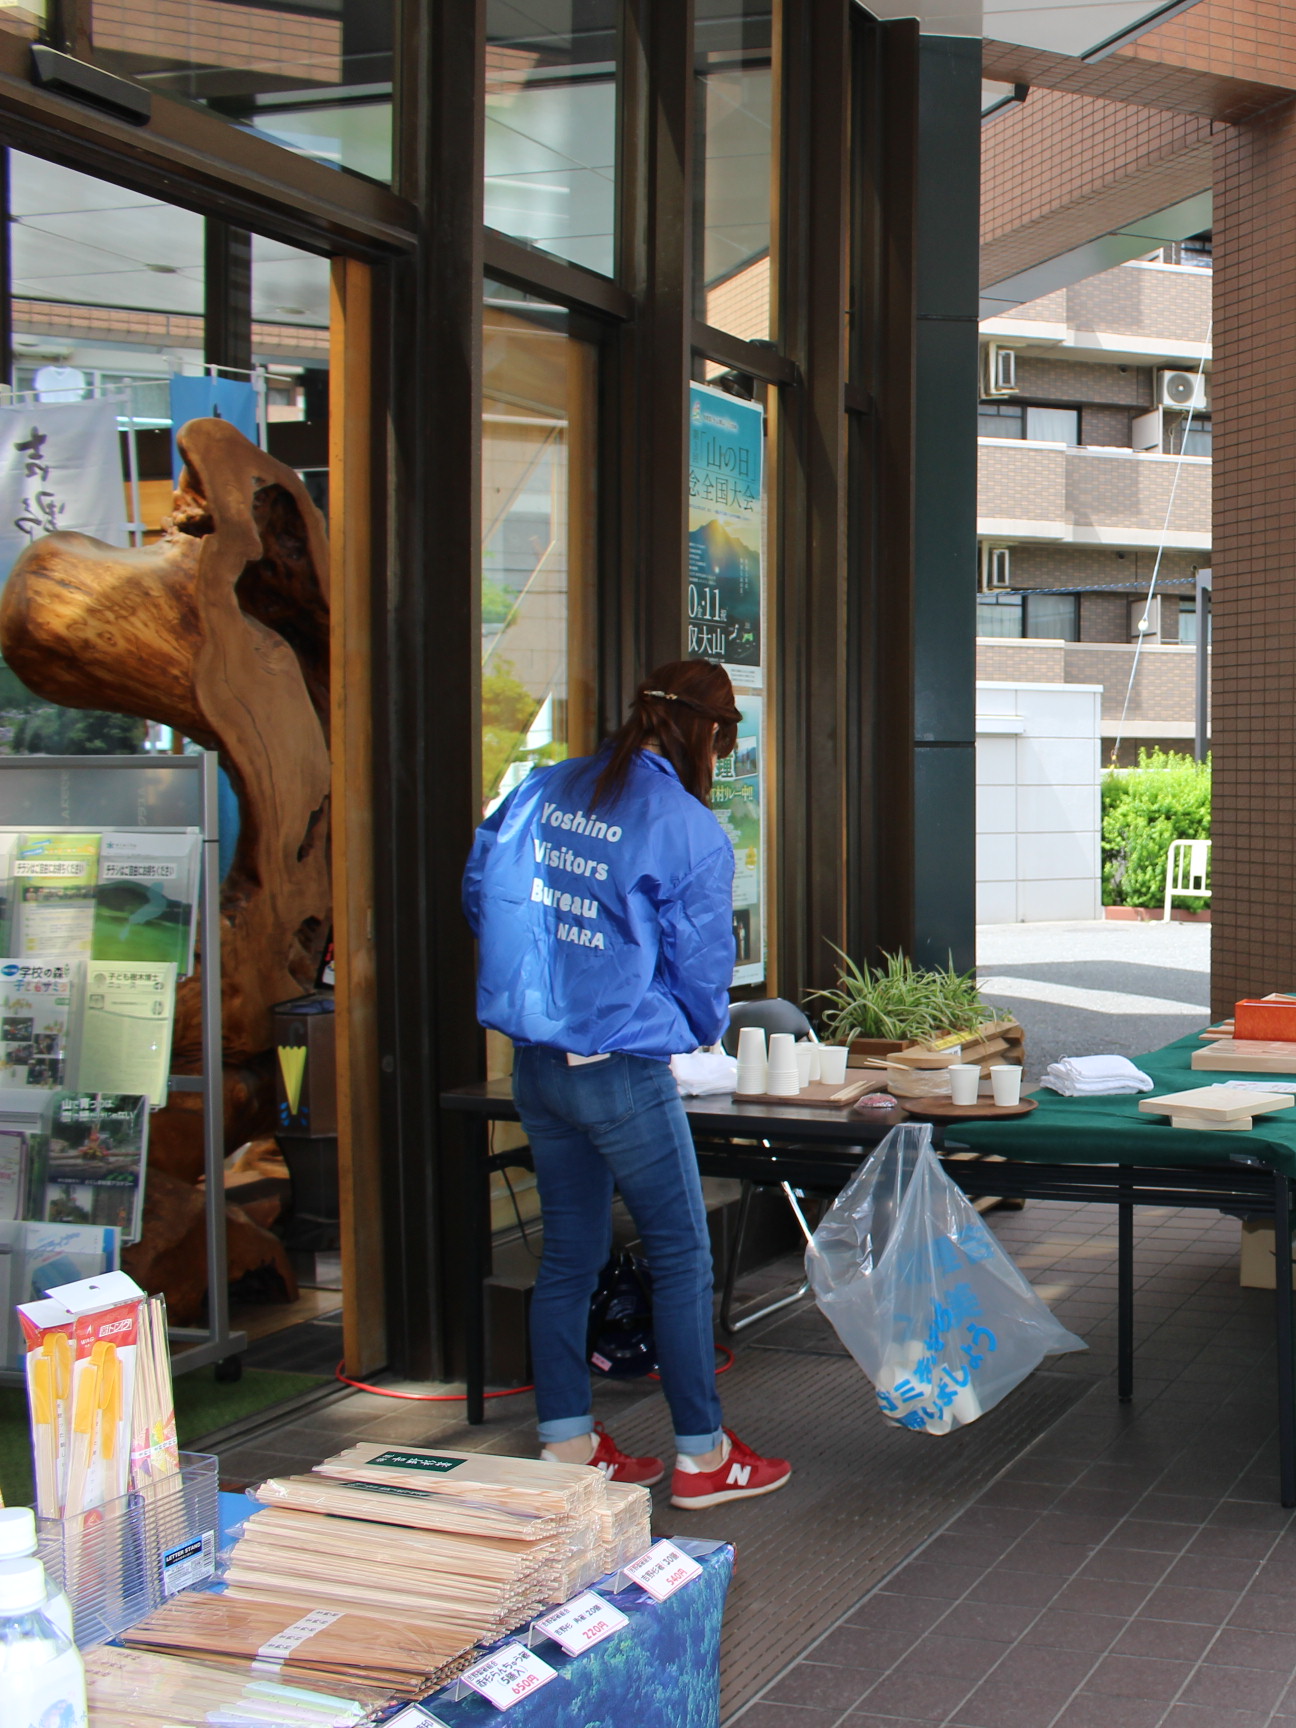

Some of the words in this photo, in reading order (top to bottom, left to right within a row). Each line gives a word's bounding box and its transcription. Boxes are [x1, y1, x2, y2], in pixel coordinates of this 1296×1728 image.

[540, 802, 623, 843] Yoshino
[533, 839, 609, 881] Visitors
[530, 877, 599, 919] Bureau
[556, 922, 605, 950] NARA
[19, 965, 64, 979] 学校の森
[725, 1462, 752, 1486] N
[665, 1567, 688, 1586] 540円
[581, 1620, 609, 1640] 220円
[511, 1673, 540, 1695] 650円
